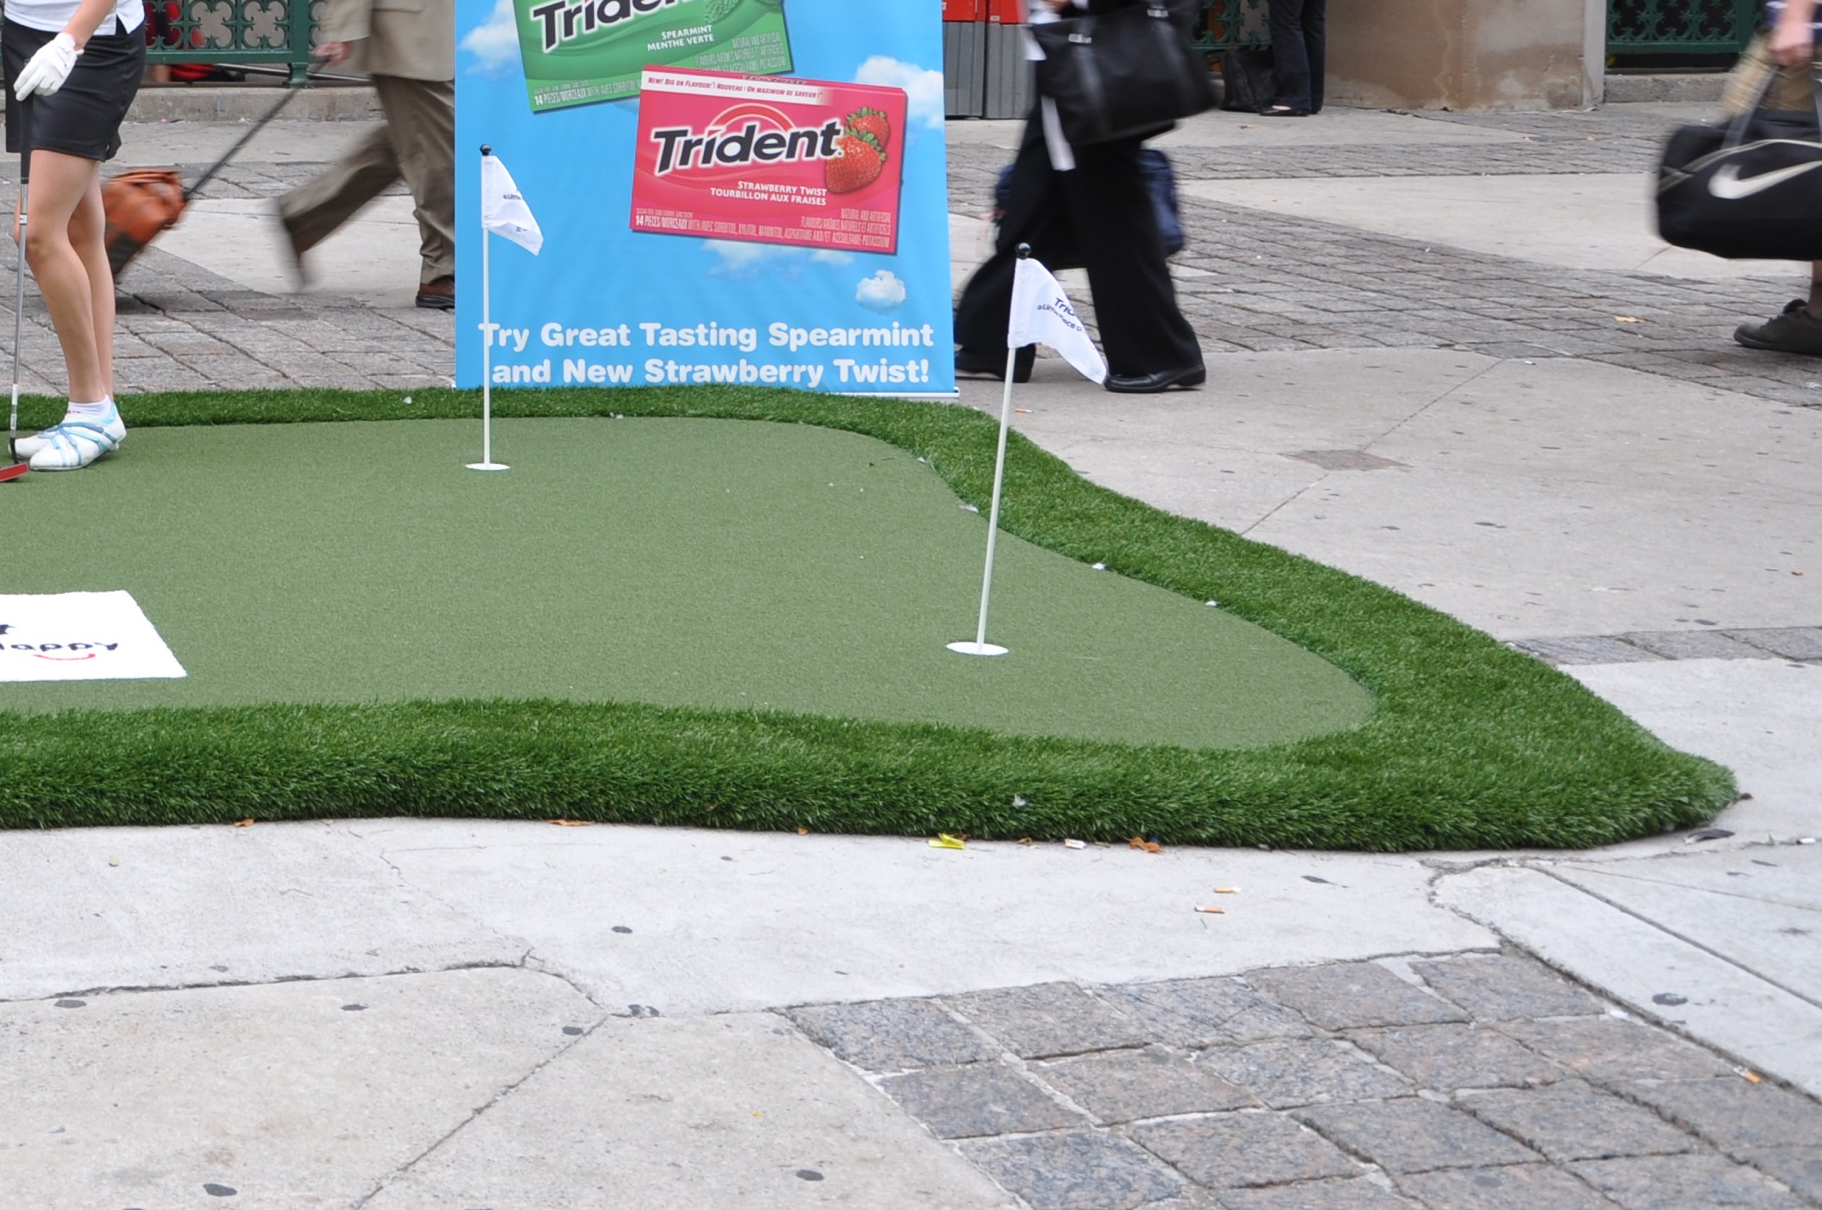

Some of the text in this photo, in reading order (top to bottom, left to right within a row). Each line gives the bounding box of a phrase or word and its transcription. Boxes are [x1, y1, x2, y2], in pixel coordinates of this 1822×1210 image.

[661, 24, 713, 40] SPEARMINT
[647, 33, 715, 52] MENTHE VERTE
[653, 121, 843, 174] Trident
[710, 187, 827, 206] TOURBILLON AUX FRAISES
[737, 180, 828, 197] STRAWBERRY TWIST
[478, 322, 934, 352] Try Great Tasting Spearmint
[492, 358, 929, 388] and New Strawberry Twist!
